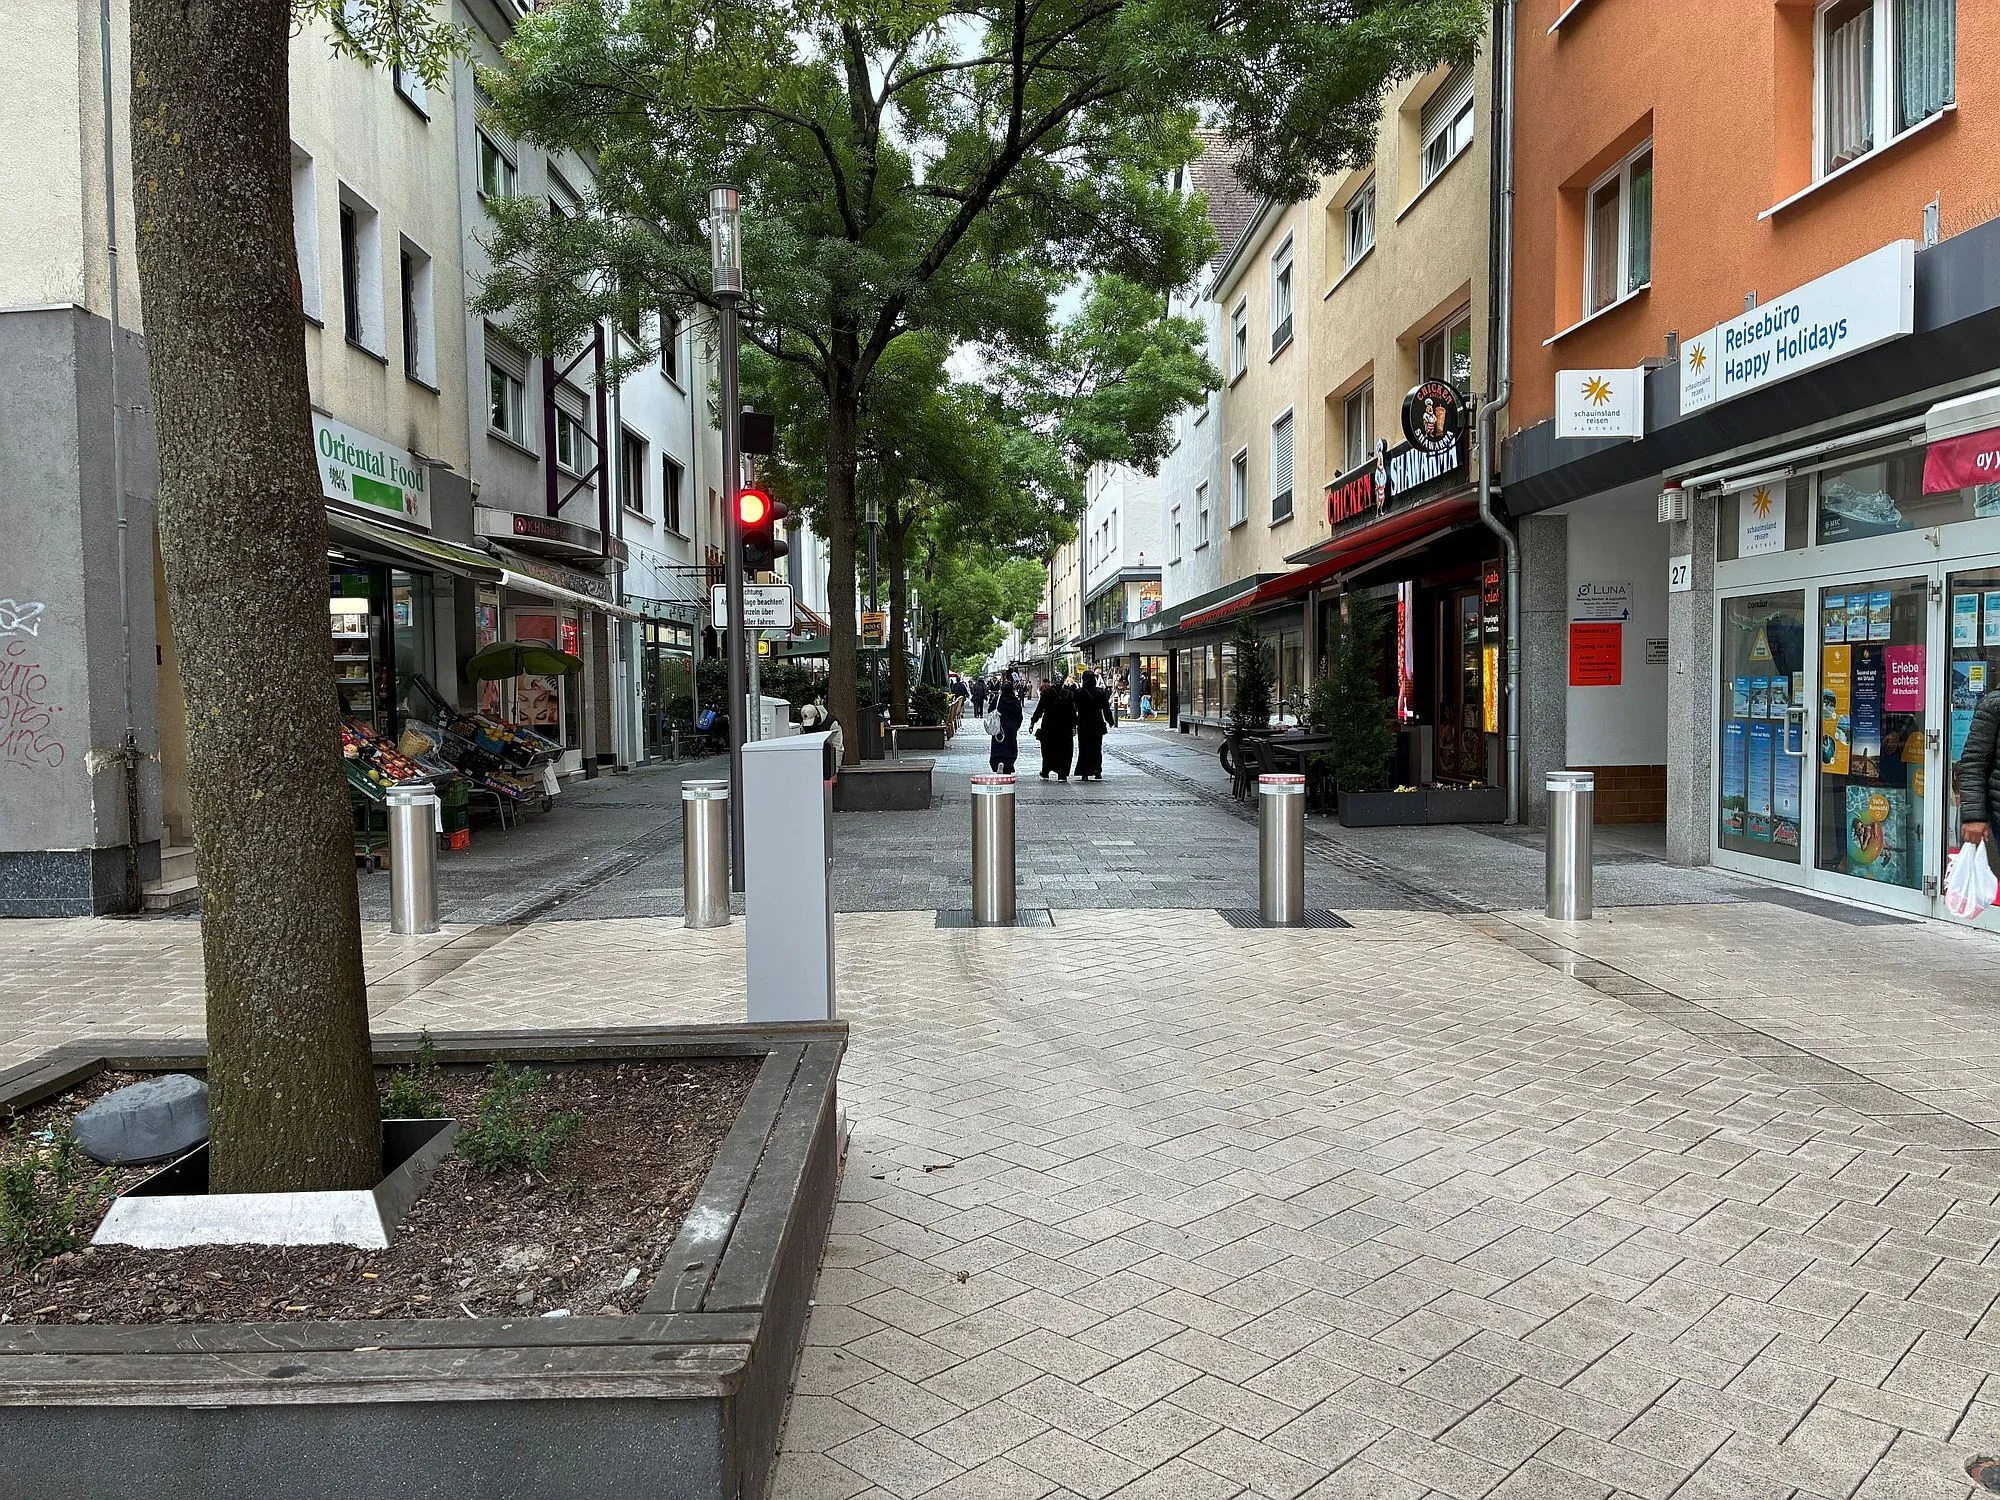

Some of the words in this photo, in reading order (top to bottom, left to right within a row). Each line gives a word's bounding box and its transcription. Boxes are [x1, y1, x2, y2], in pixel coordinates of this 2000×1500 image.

[1725, 304, 1800, 354] Reisebüro
[1725, 349, 1770, 385] Happy
[1776, 318, 1848, 364] Holidays
[1416, 383, 1453, 405] CHICKEN
[1574, 409, 1621, 418] schauinsland
[1414, 428, 1455, 451] SHAWARMA
[318, 427, 386, 479] Oriental
[388, 456, 424, 492] Food
[1327, 473, 1373, 526] CHICKEN
[1746, 521, 1777, 534] schauinsland
[1754, 533, 1769, 541] reisen
[1672, 565, 1687, 585] 27
[1593, 584, 1626, 595] LUNA
[1747, 600, 1768, 609] condor
[1892, 662, 1919, 674] Erlebe
[1892, 675, 1919, 686] echtes
